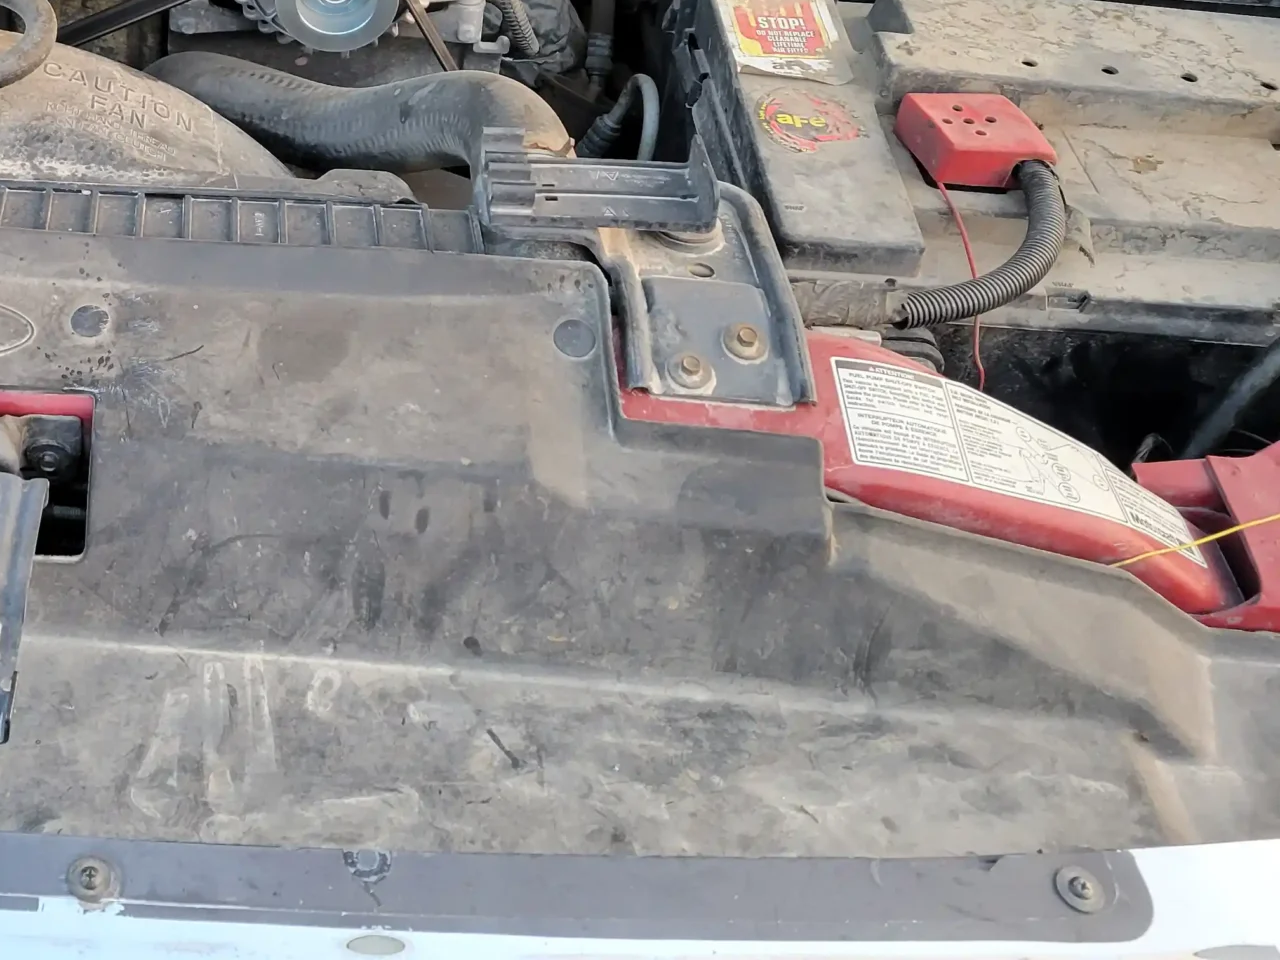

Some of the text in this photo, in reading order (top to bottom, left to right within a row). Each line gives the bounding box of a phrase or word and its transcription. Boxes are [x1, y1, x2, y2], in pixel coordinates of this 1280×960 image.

[758, 16, 806, 31] STOP!
[43, 62, 192, 132] CAUTION
[90, 94, 146, 129] FAN
